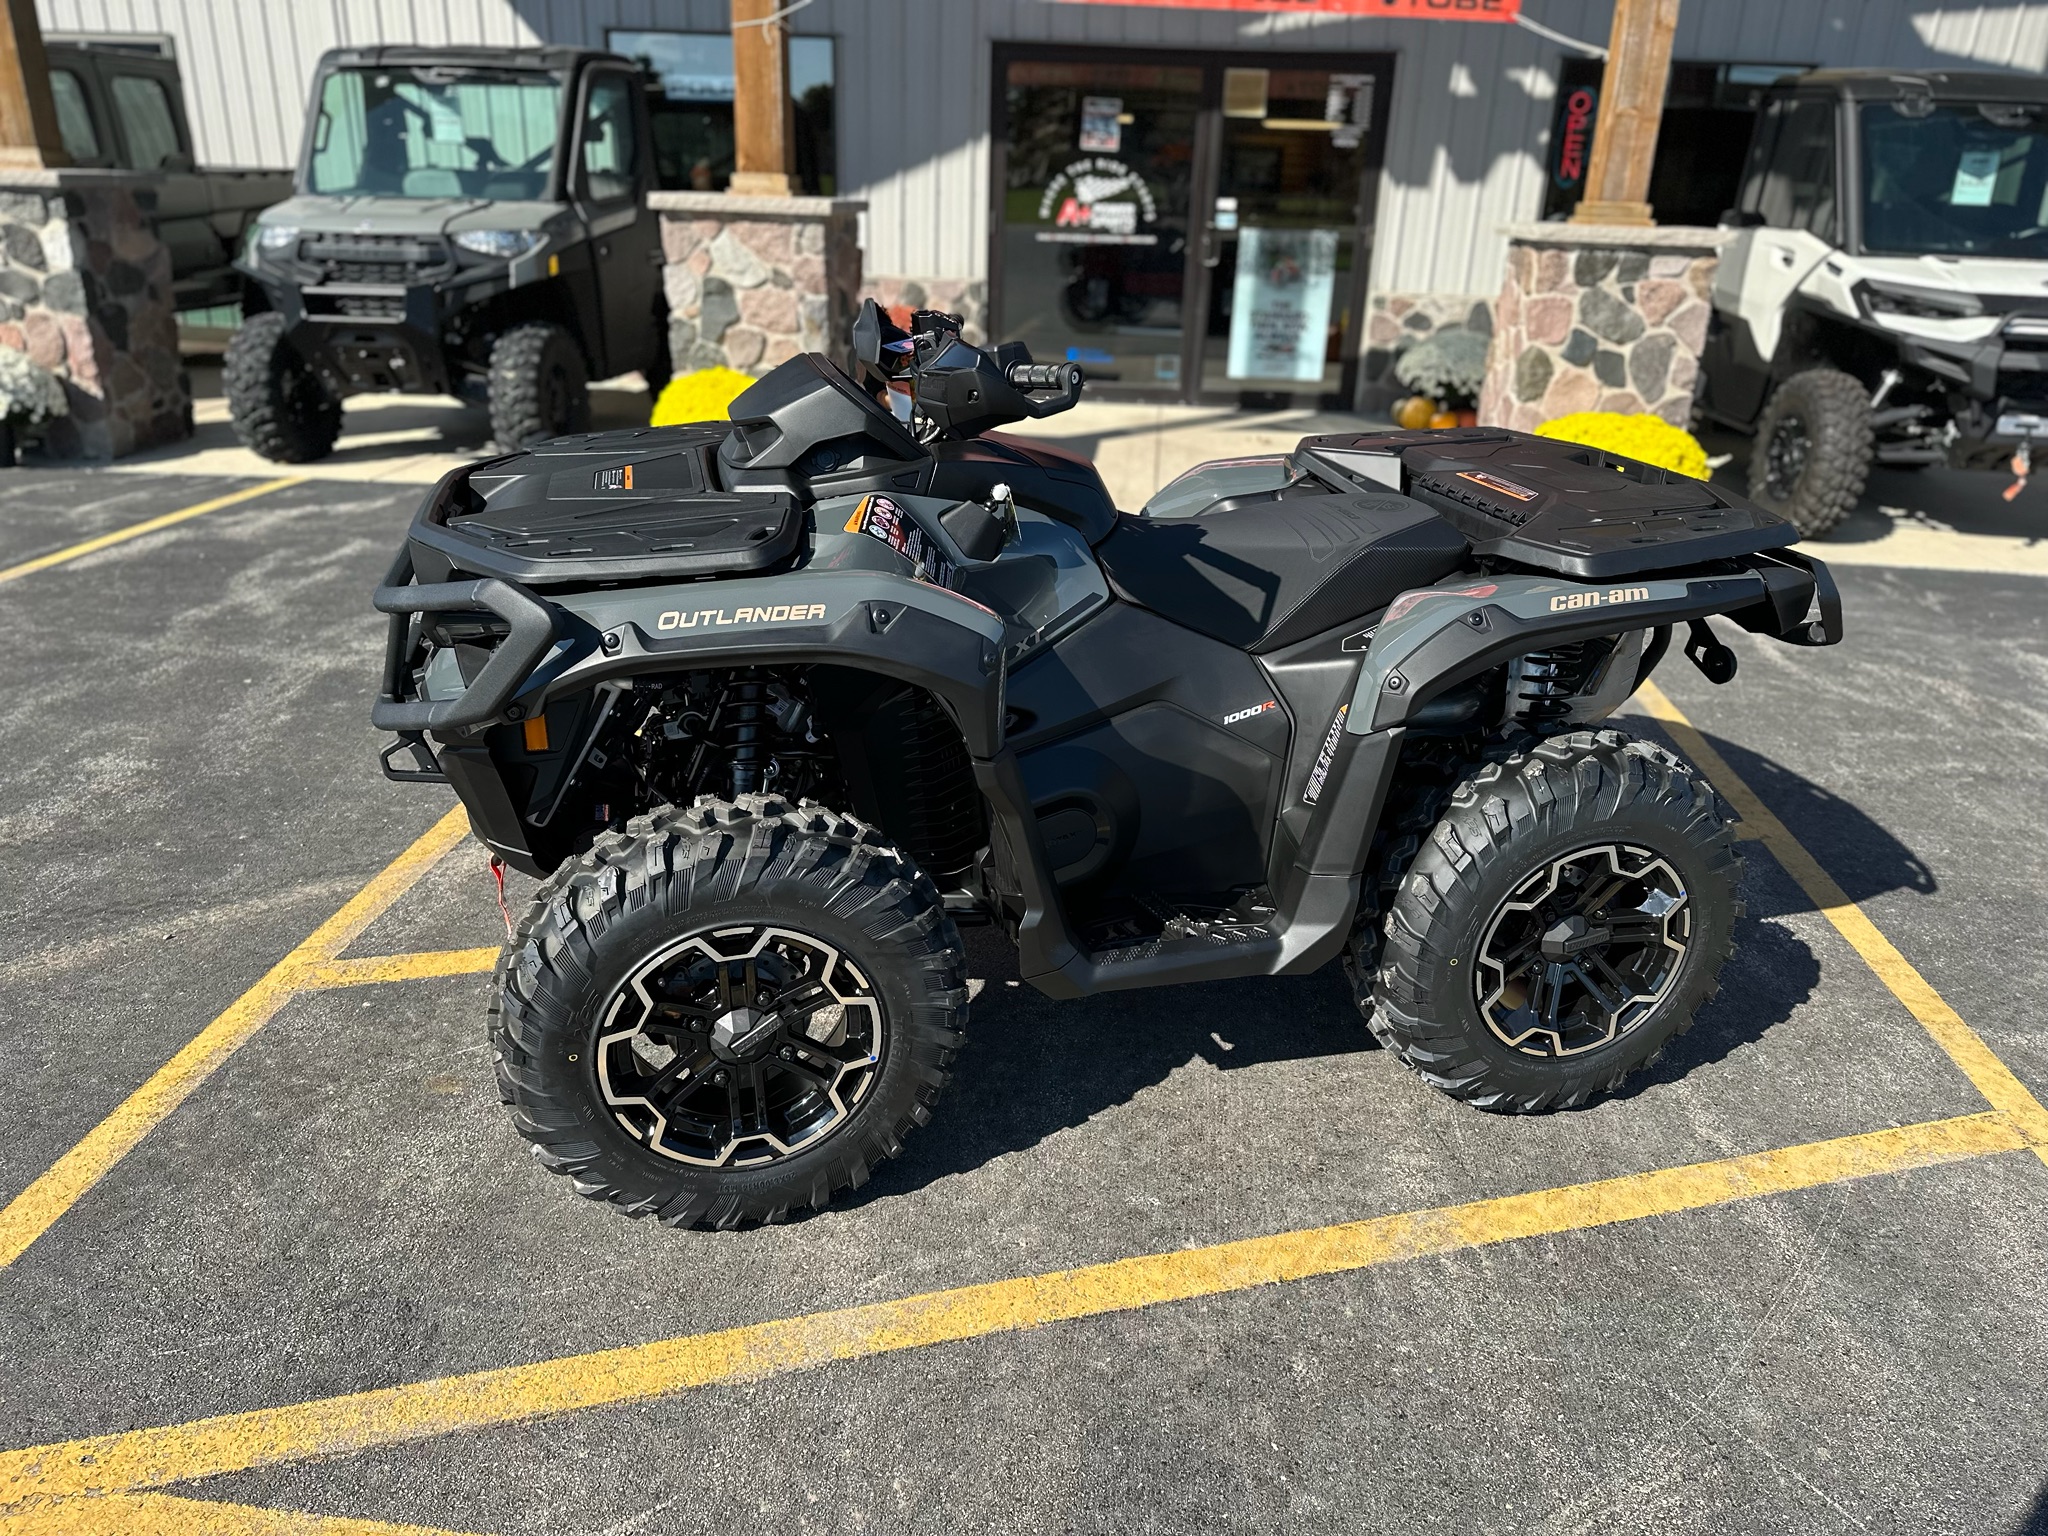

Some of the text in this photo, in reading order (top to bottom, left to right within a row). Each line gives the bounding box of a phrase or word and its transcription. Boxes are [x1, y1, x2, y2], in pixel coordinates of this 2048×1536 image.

[1560, 90, 1593, 180] OPEN
[1550, 587, 1649, 612] can-am
[657, 603, 826, 631] OUTLANDER
[1223, 700, 1276, 725] 1000R
